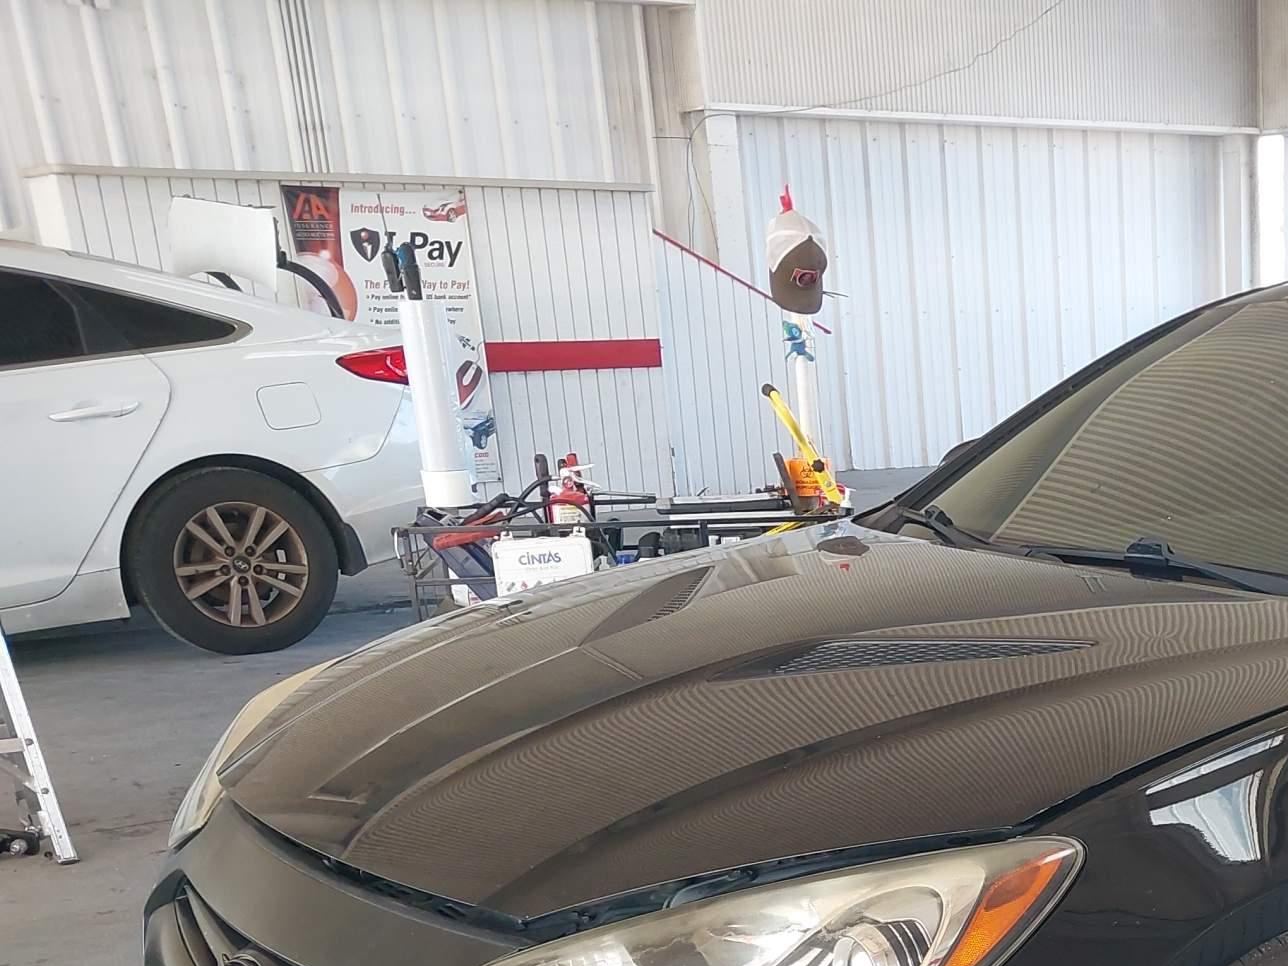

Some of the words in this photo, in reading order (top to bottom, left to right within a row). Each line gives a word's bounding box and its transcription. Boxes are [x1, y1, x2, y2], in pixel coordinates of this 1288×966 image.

[351, 203, 416, 216] Introducing...
[365, 280, 380, 289] The
[440, 280, 449, 289] to
[451, 281, 470, 291] Pay!
